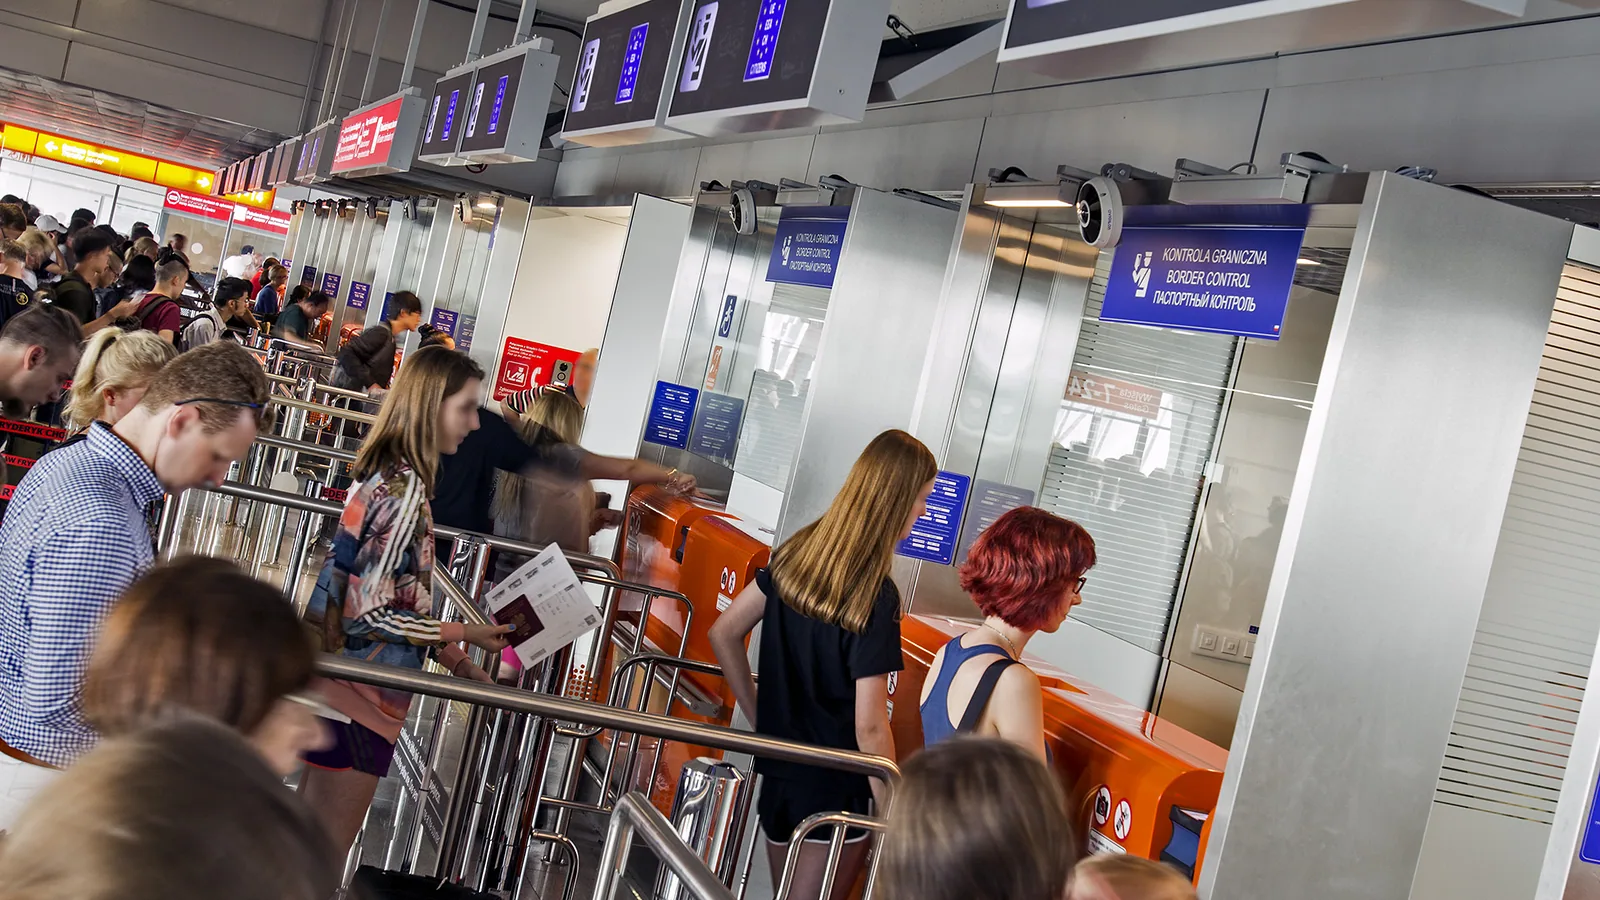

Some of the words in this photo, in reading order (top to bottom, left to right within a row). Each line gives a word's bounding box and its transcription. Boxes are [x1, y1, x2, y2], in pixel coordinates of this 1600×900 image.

[750, 61, 768, 75] CITIZENS
[796, 233, 816, 243] KONTROLA
[816, 234, 839, 244] GRANICZNA
[796, 247, 812, 257] BORDER
[813, 248, 831, 258] CONTROL
[1163, 248, 1212, 264] KONTROLA
[1212, 249, 1267, 265] GRANICZNA
[790, 260, 813, 271] ПАСПОРТНЫЙ
[813, 262, 831, 273] КОНТРОЛЬ
[1166, 270, 1204, 286] BORDER
[1206, 272, 1251, 288] CONTROL
[1153, 290, 1210, 308] ПАСПОРТНЫЙ
[1210, 295, 1256, 312] КОНТРОЛЬ
